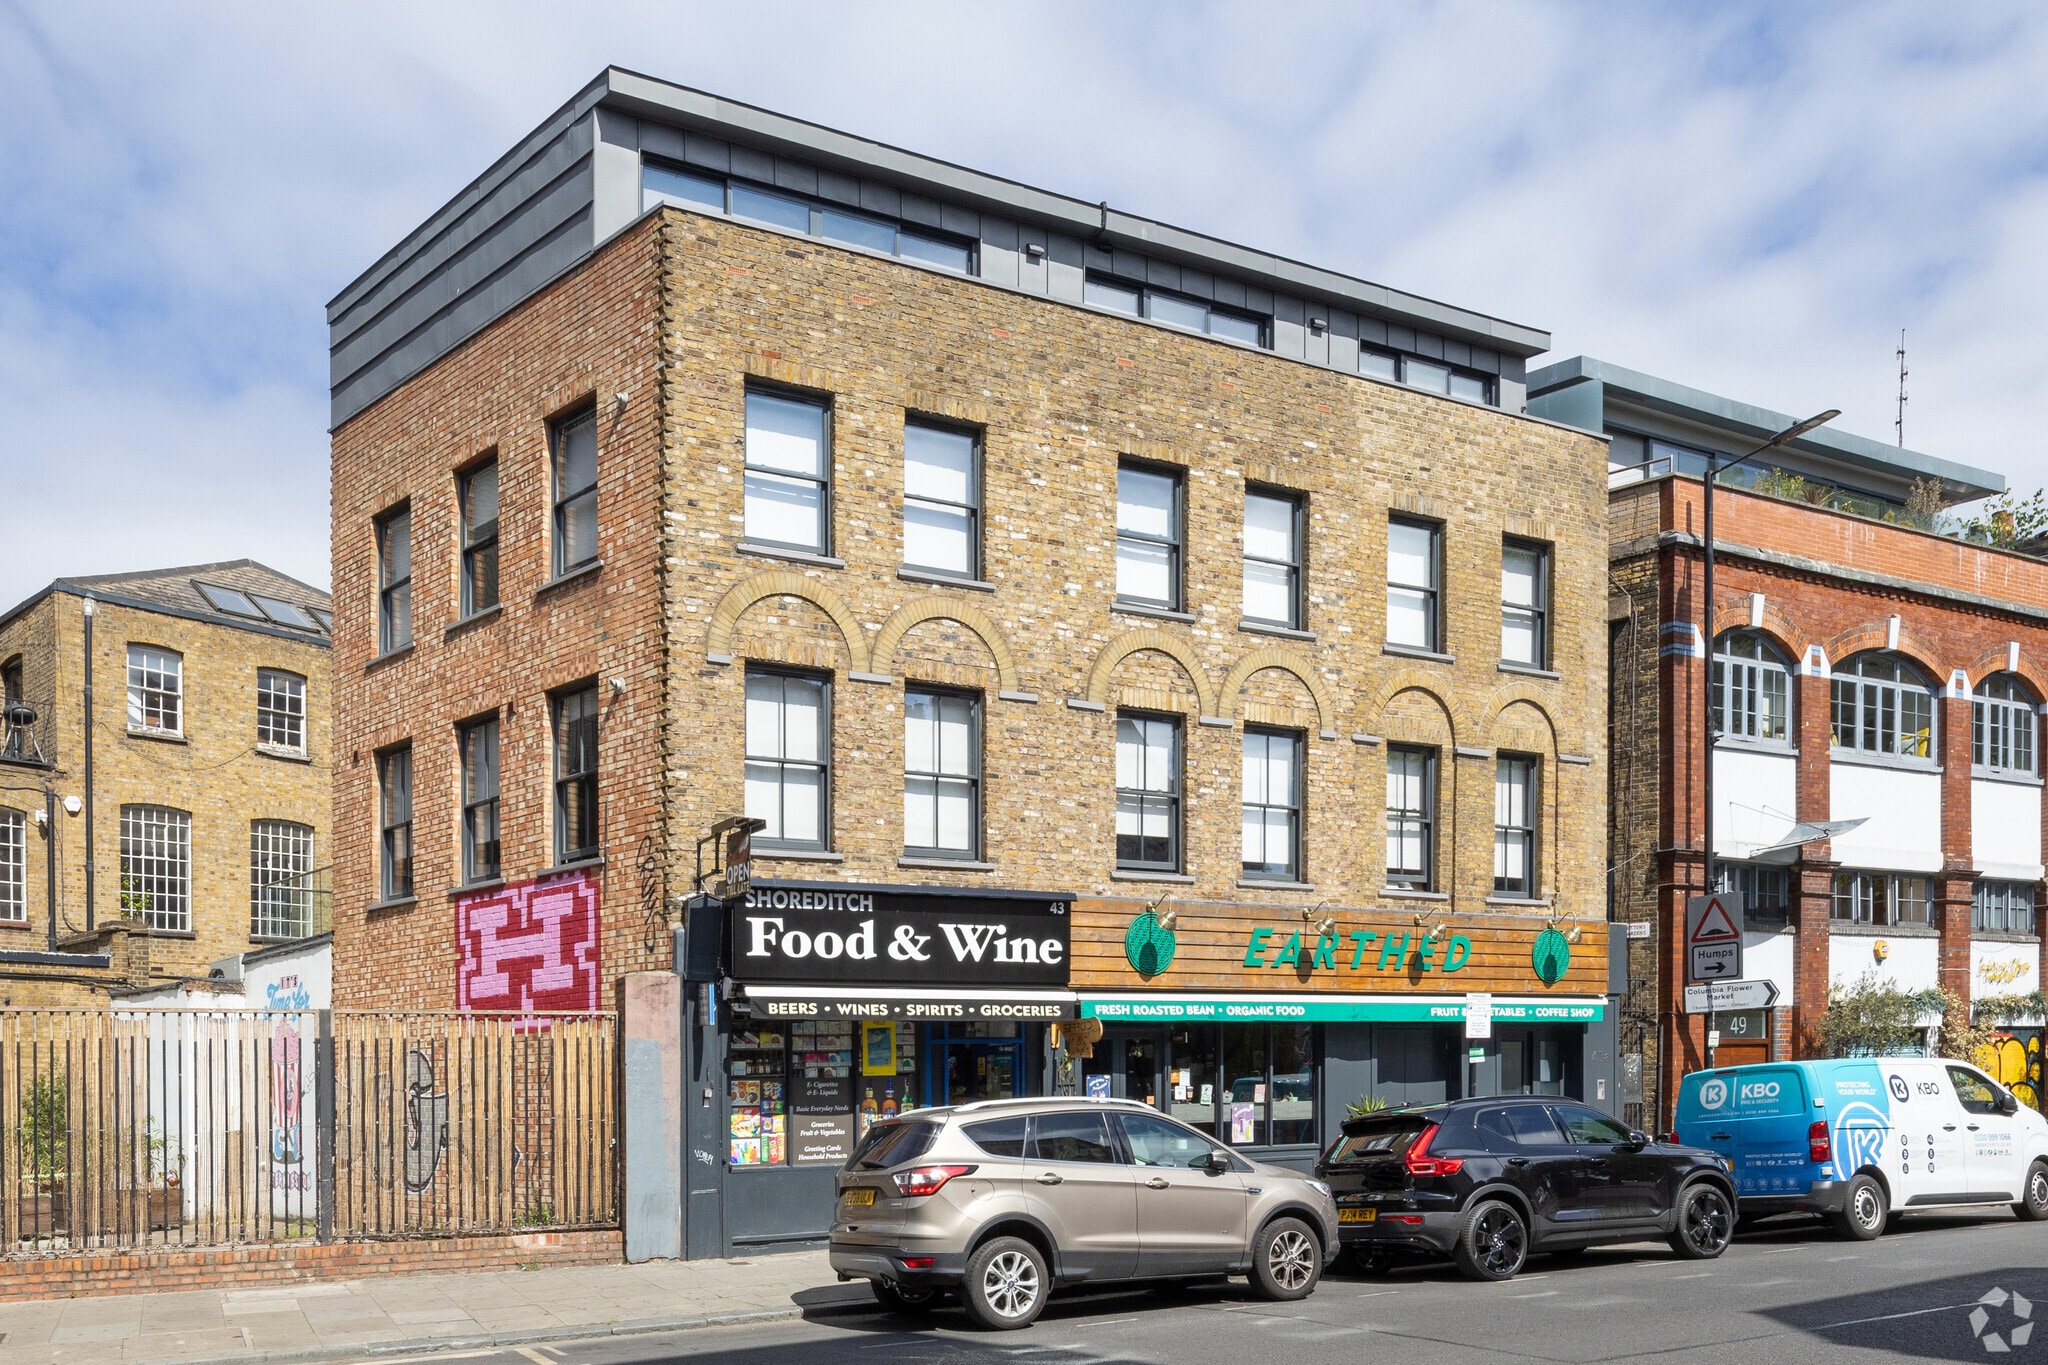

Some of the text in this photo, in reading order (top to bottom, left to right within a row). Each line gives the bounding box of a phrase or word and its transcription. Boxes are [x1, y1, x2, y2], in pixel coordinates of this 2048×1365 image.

[727, 861, 750, 885] OPEN
[745, 889, 874, 912] SHOREDITCH
[1050, 902, 1065, 915] 43
[745, 916, 1063, 964] Food & Wine
[1243, 927, 1473, 972] EARTHED
[1698, 948, 1734, 959] Humps
[280, 975, 298, 989] IT'S
[266, 983, 291, 1010] Time
[1687, 987, 1724, 995] Columbia
[1706, 993, 1734, 1001] Market
[768, 1002, 1061, 1017] BEERS WINES SPIRITS GROCERIES
[1095, 1005, 1305, 1016] FRESH ROASTED BEAN ORGANIC FOOD
[1430, 1007, 1459, 1017] FRUIT
[1490, 1007, 1526, 1017] ETABLES
[1535, 1008, 1569, 1017] COFFEE
[1571, 1008, 1595, 1017] SHOP
[1730, 1016, 1747, 1034] 49
[1741, 1082, 1780, 1099] KBO
[1835, 1081, 1871, 1089] PROTECTING
[1916, 1082, 1940, 1095] KBO
[810, 1105, 834, 1113] Everyday
[820, 1129, 845, 1137] Vegetables
[1988, 1133, 1998, 1141] 999
[1999, 1133, 2011, 1141] 1066
[804, 1145, 826, 1153] Greeting
[798, 1153, 825, 1161] Household
[1359, 1209, 1374, 1219] REY
